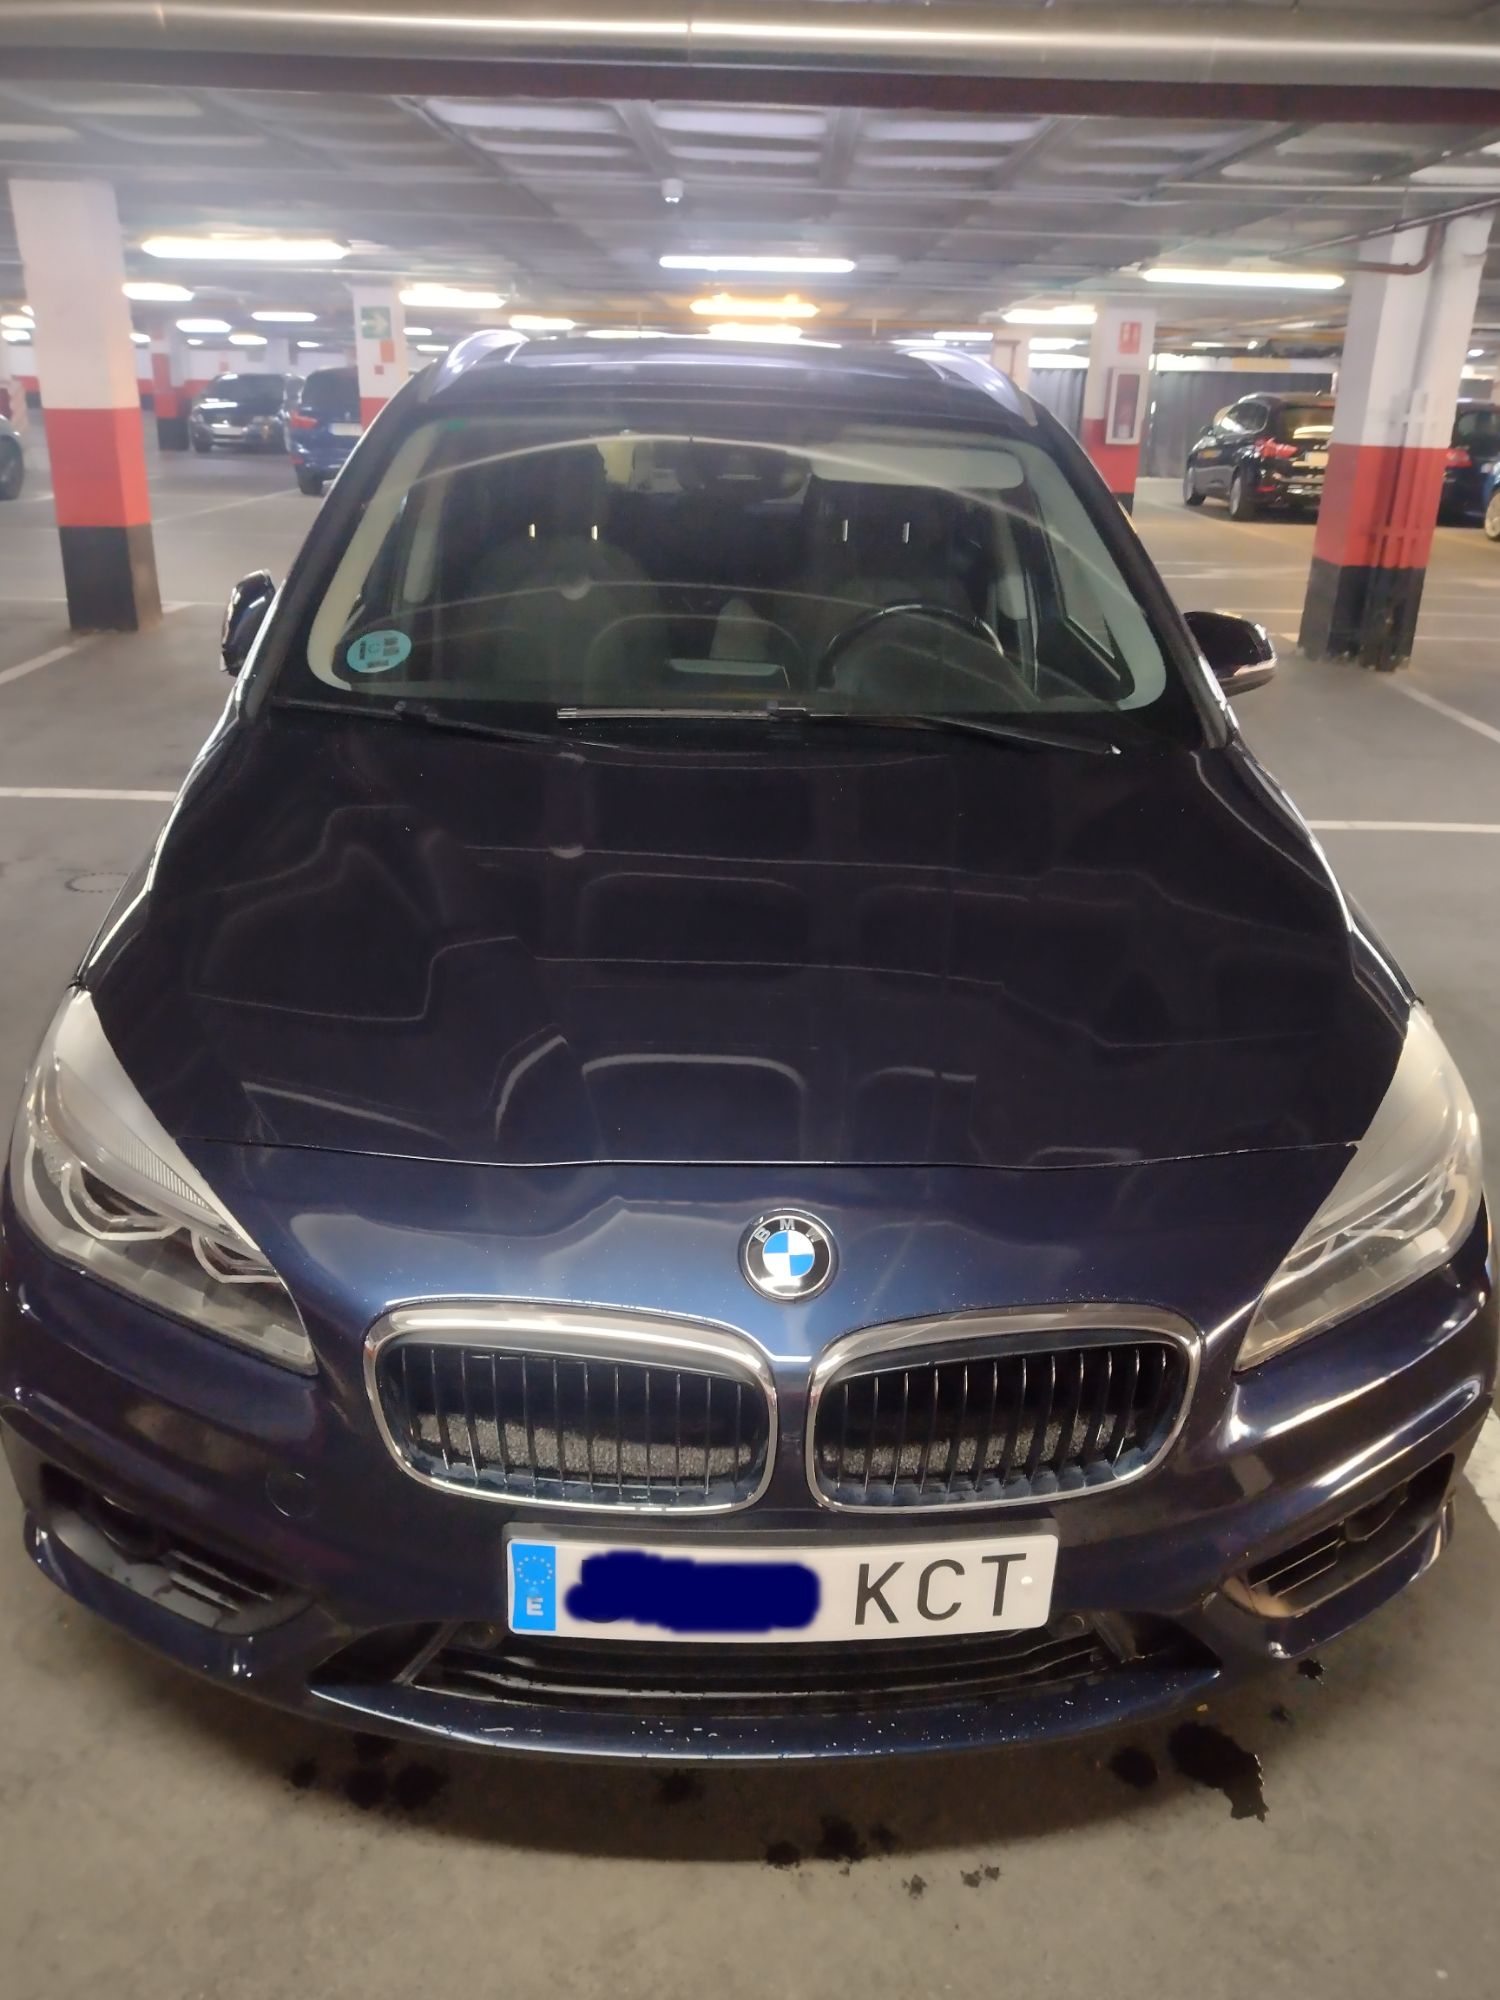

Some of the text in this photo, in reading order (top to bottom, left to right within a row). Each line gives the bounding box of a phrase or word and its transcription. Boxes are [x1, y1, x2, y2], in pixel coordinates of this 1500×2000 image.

[753, 1218, 824, 1243] BMW
[526, 1553, 1027, 1626] E KCT
